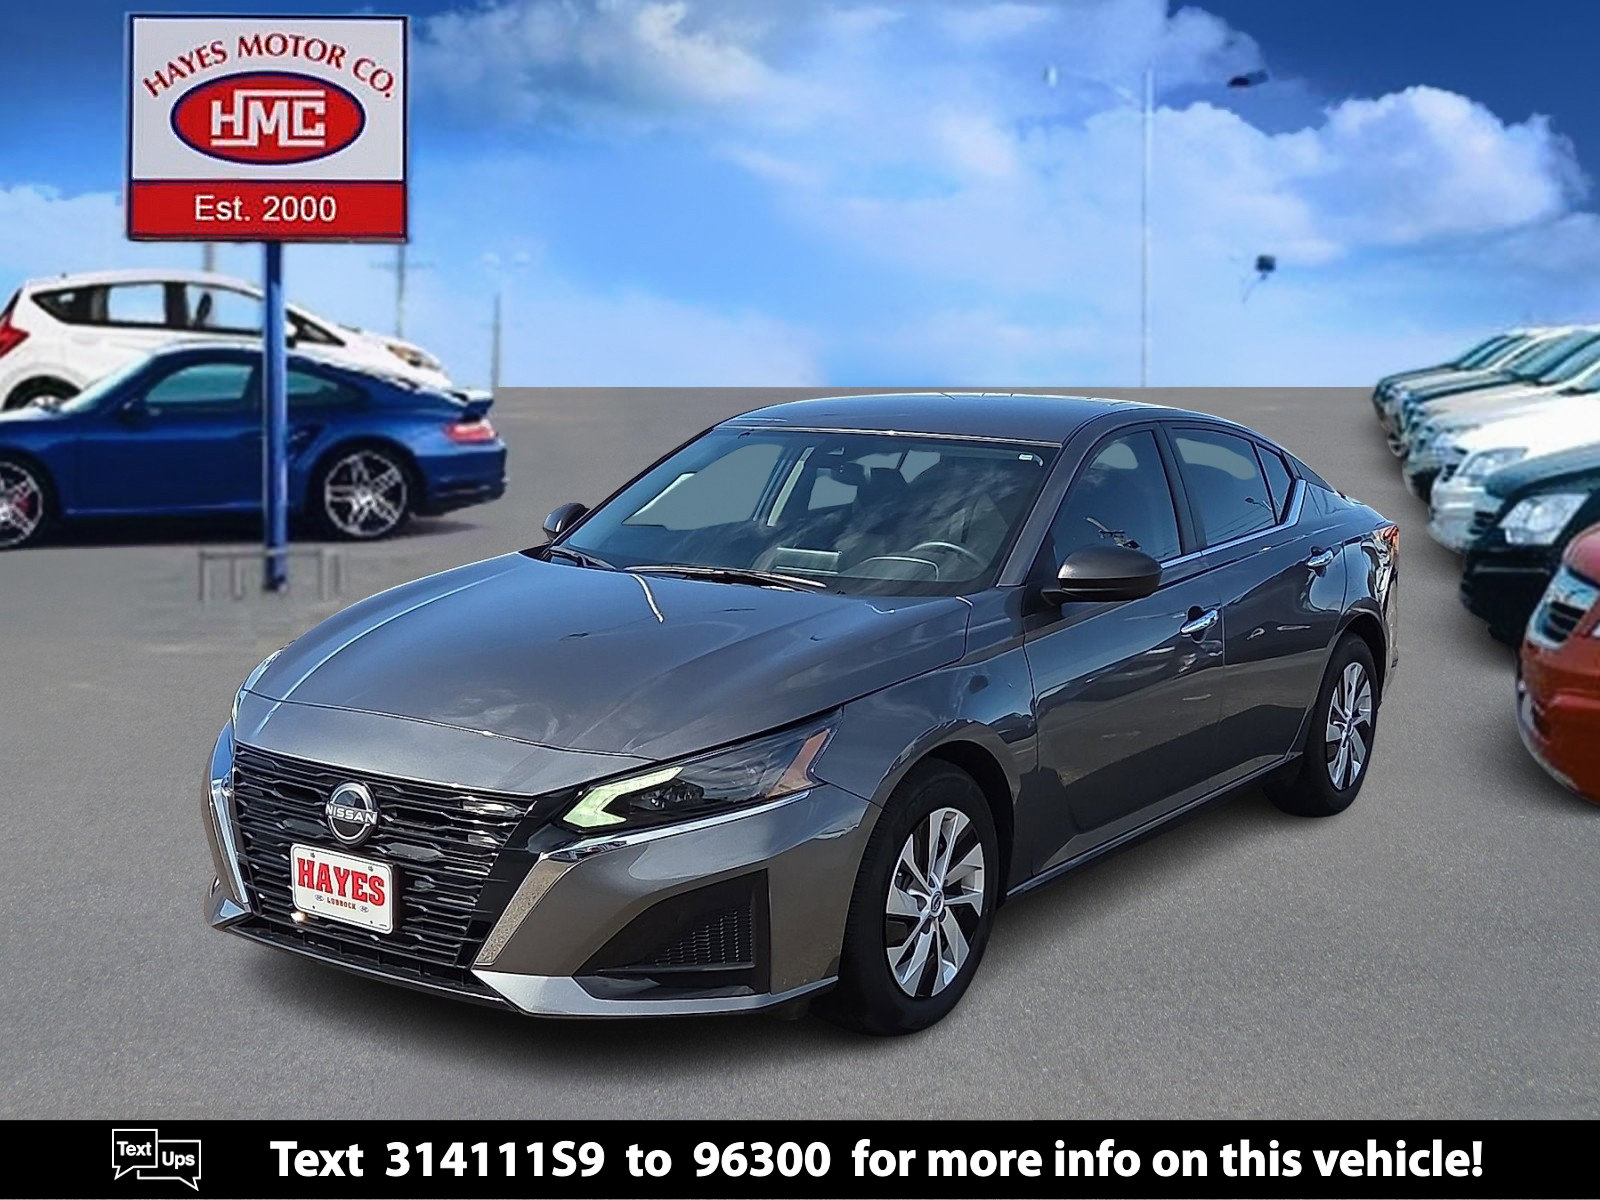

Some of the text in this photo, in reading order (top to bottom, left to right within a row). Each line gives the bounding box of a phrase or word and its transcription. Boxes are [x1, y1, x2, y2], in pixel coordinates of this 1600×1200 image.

[143, 33, 394, 98] HAYES MOTOR CO.
[210, 89, 326, 147] HMC
[194, 195, 337, 222] Est. 2000
[325, 804, 378, 825] NISSAN
[297, 857, 385, 907] HAYES
